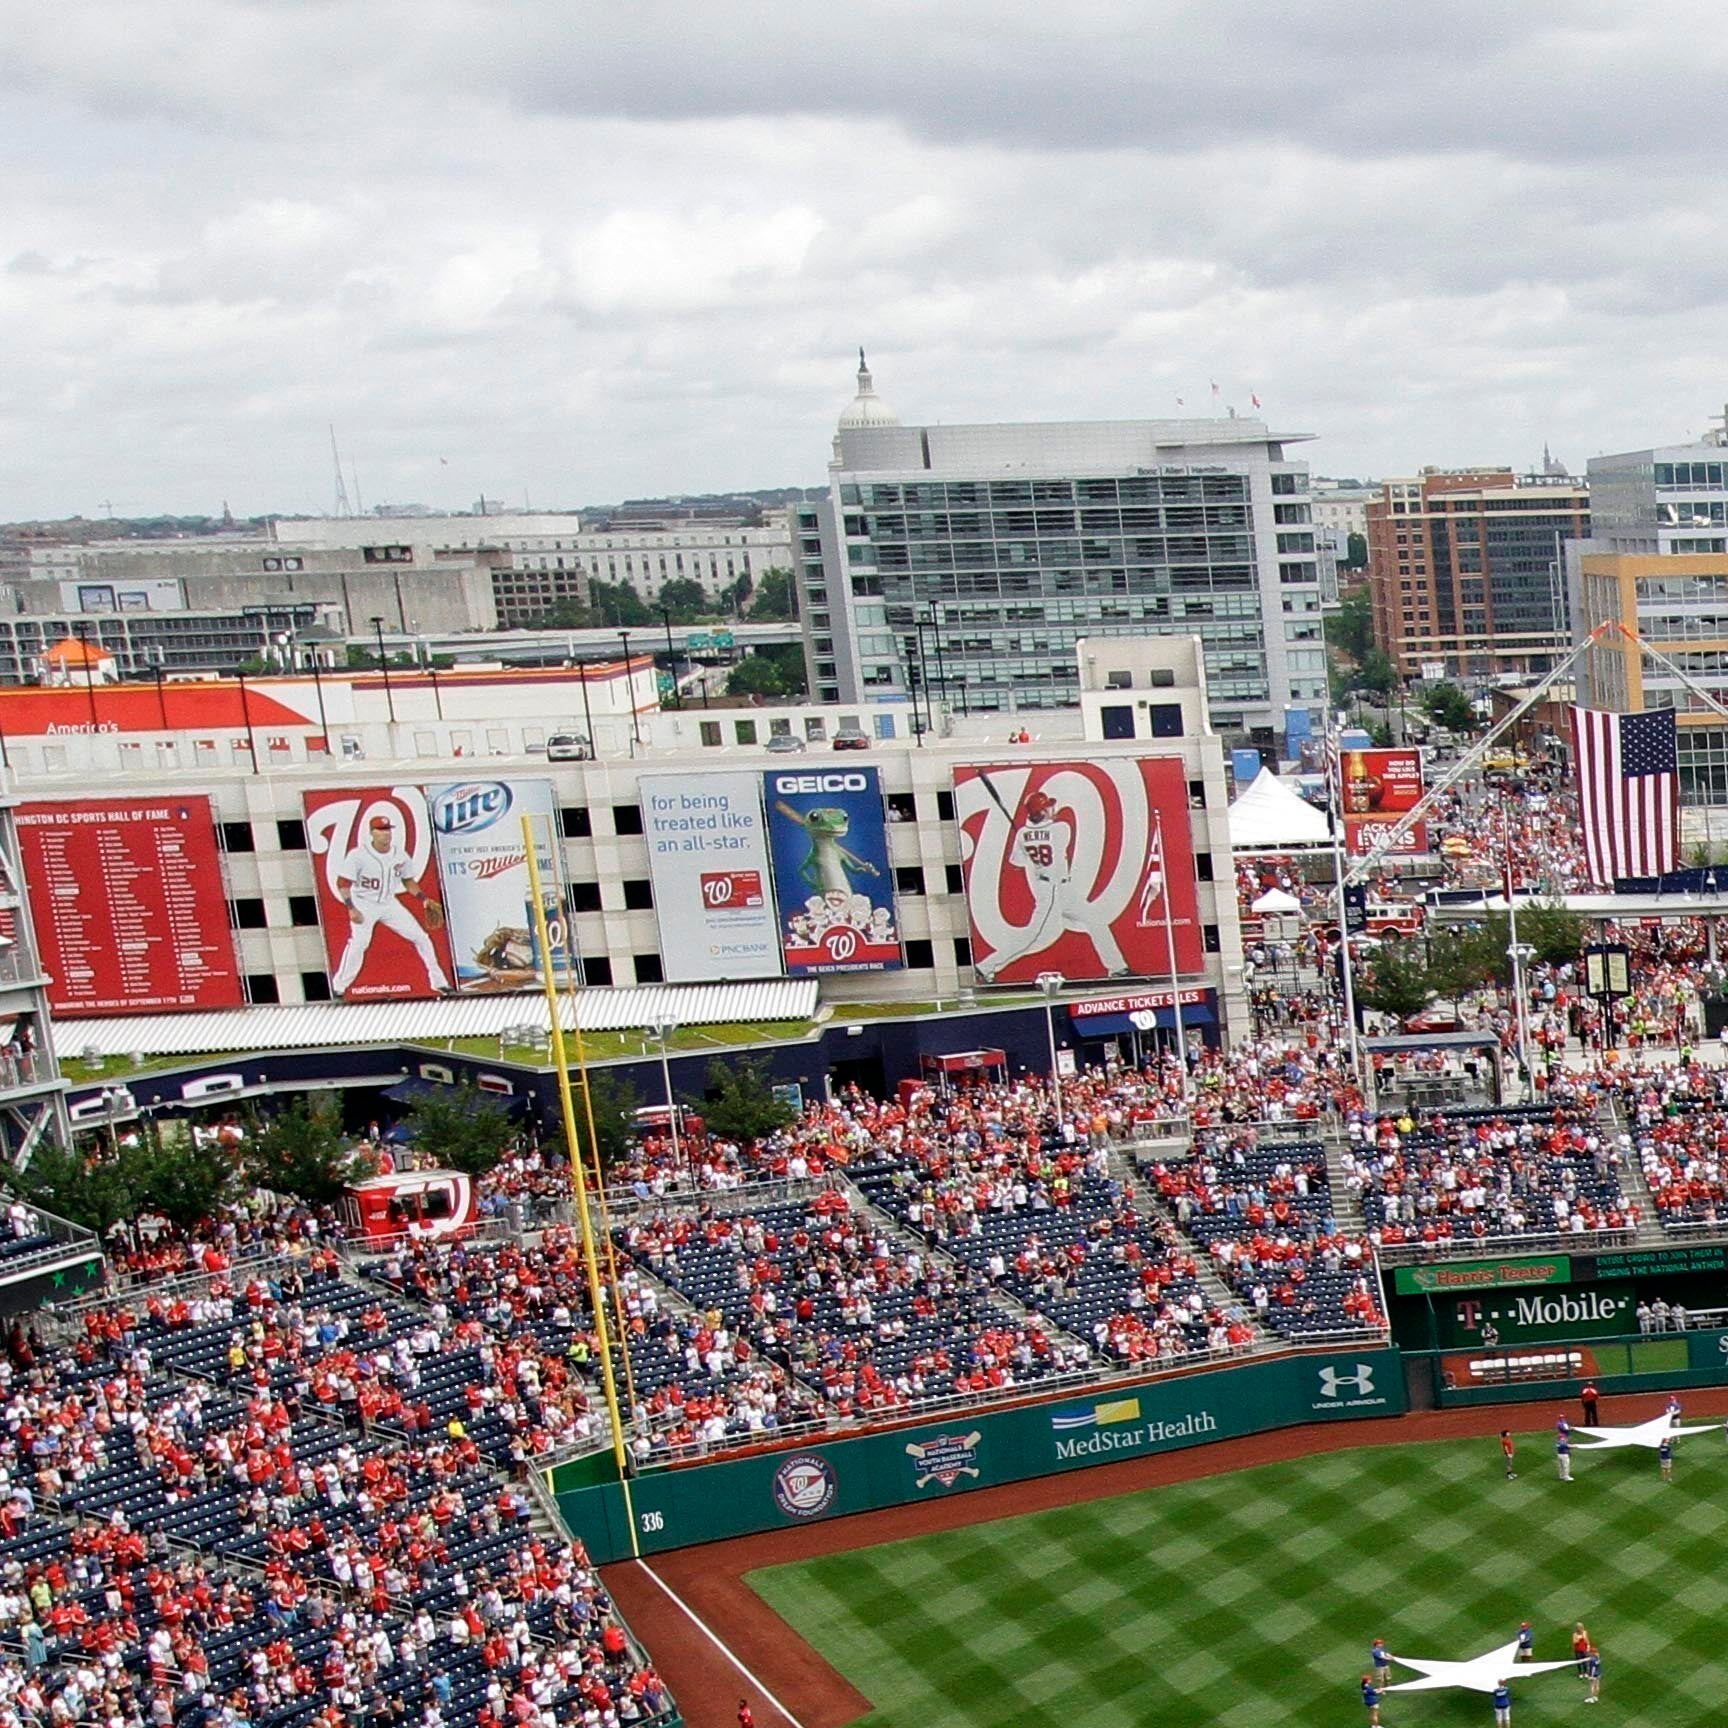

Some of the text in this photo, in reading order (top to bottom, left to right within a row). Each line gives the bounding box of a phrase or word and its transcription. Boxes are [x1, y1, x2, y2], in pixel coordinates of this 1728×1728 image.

[776, 773, 868, 794] GEICO
[443, 787, 500, 828] Lite
[651, 794, 729, 811] for being
[15, 808, 171, 825] HINGTON DC SPORTS HALL OF FAME
[654, 812, 753, 831] treated like
[657, 834, 751, 852] an all-star.
[1026, 845, 1053, 867] 28
[360, 876, 379, 889] 20
[1136, 918, 1191, 928] nationas.com
[351, 984, 411, 995] nationals.com
[1077, 993, 1199, 1014] ADVANCE TICKET SLES
[1436, 1268, 1494, 1285] Harris
[1499, 1263, 1556, 1281] Teeter
[1631, 1265, 1647, 1276] THE
[1515, 1292, 1616, 1326] Mobile
[1054, 1409, 1218, 1461] MedStar Health
[641, 1511, 664, 1533] 336
